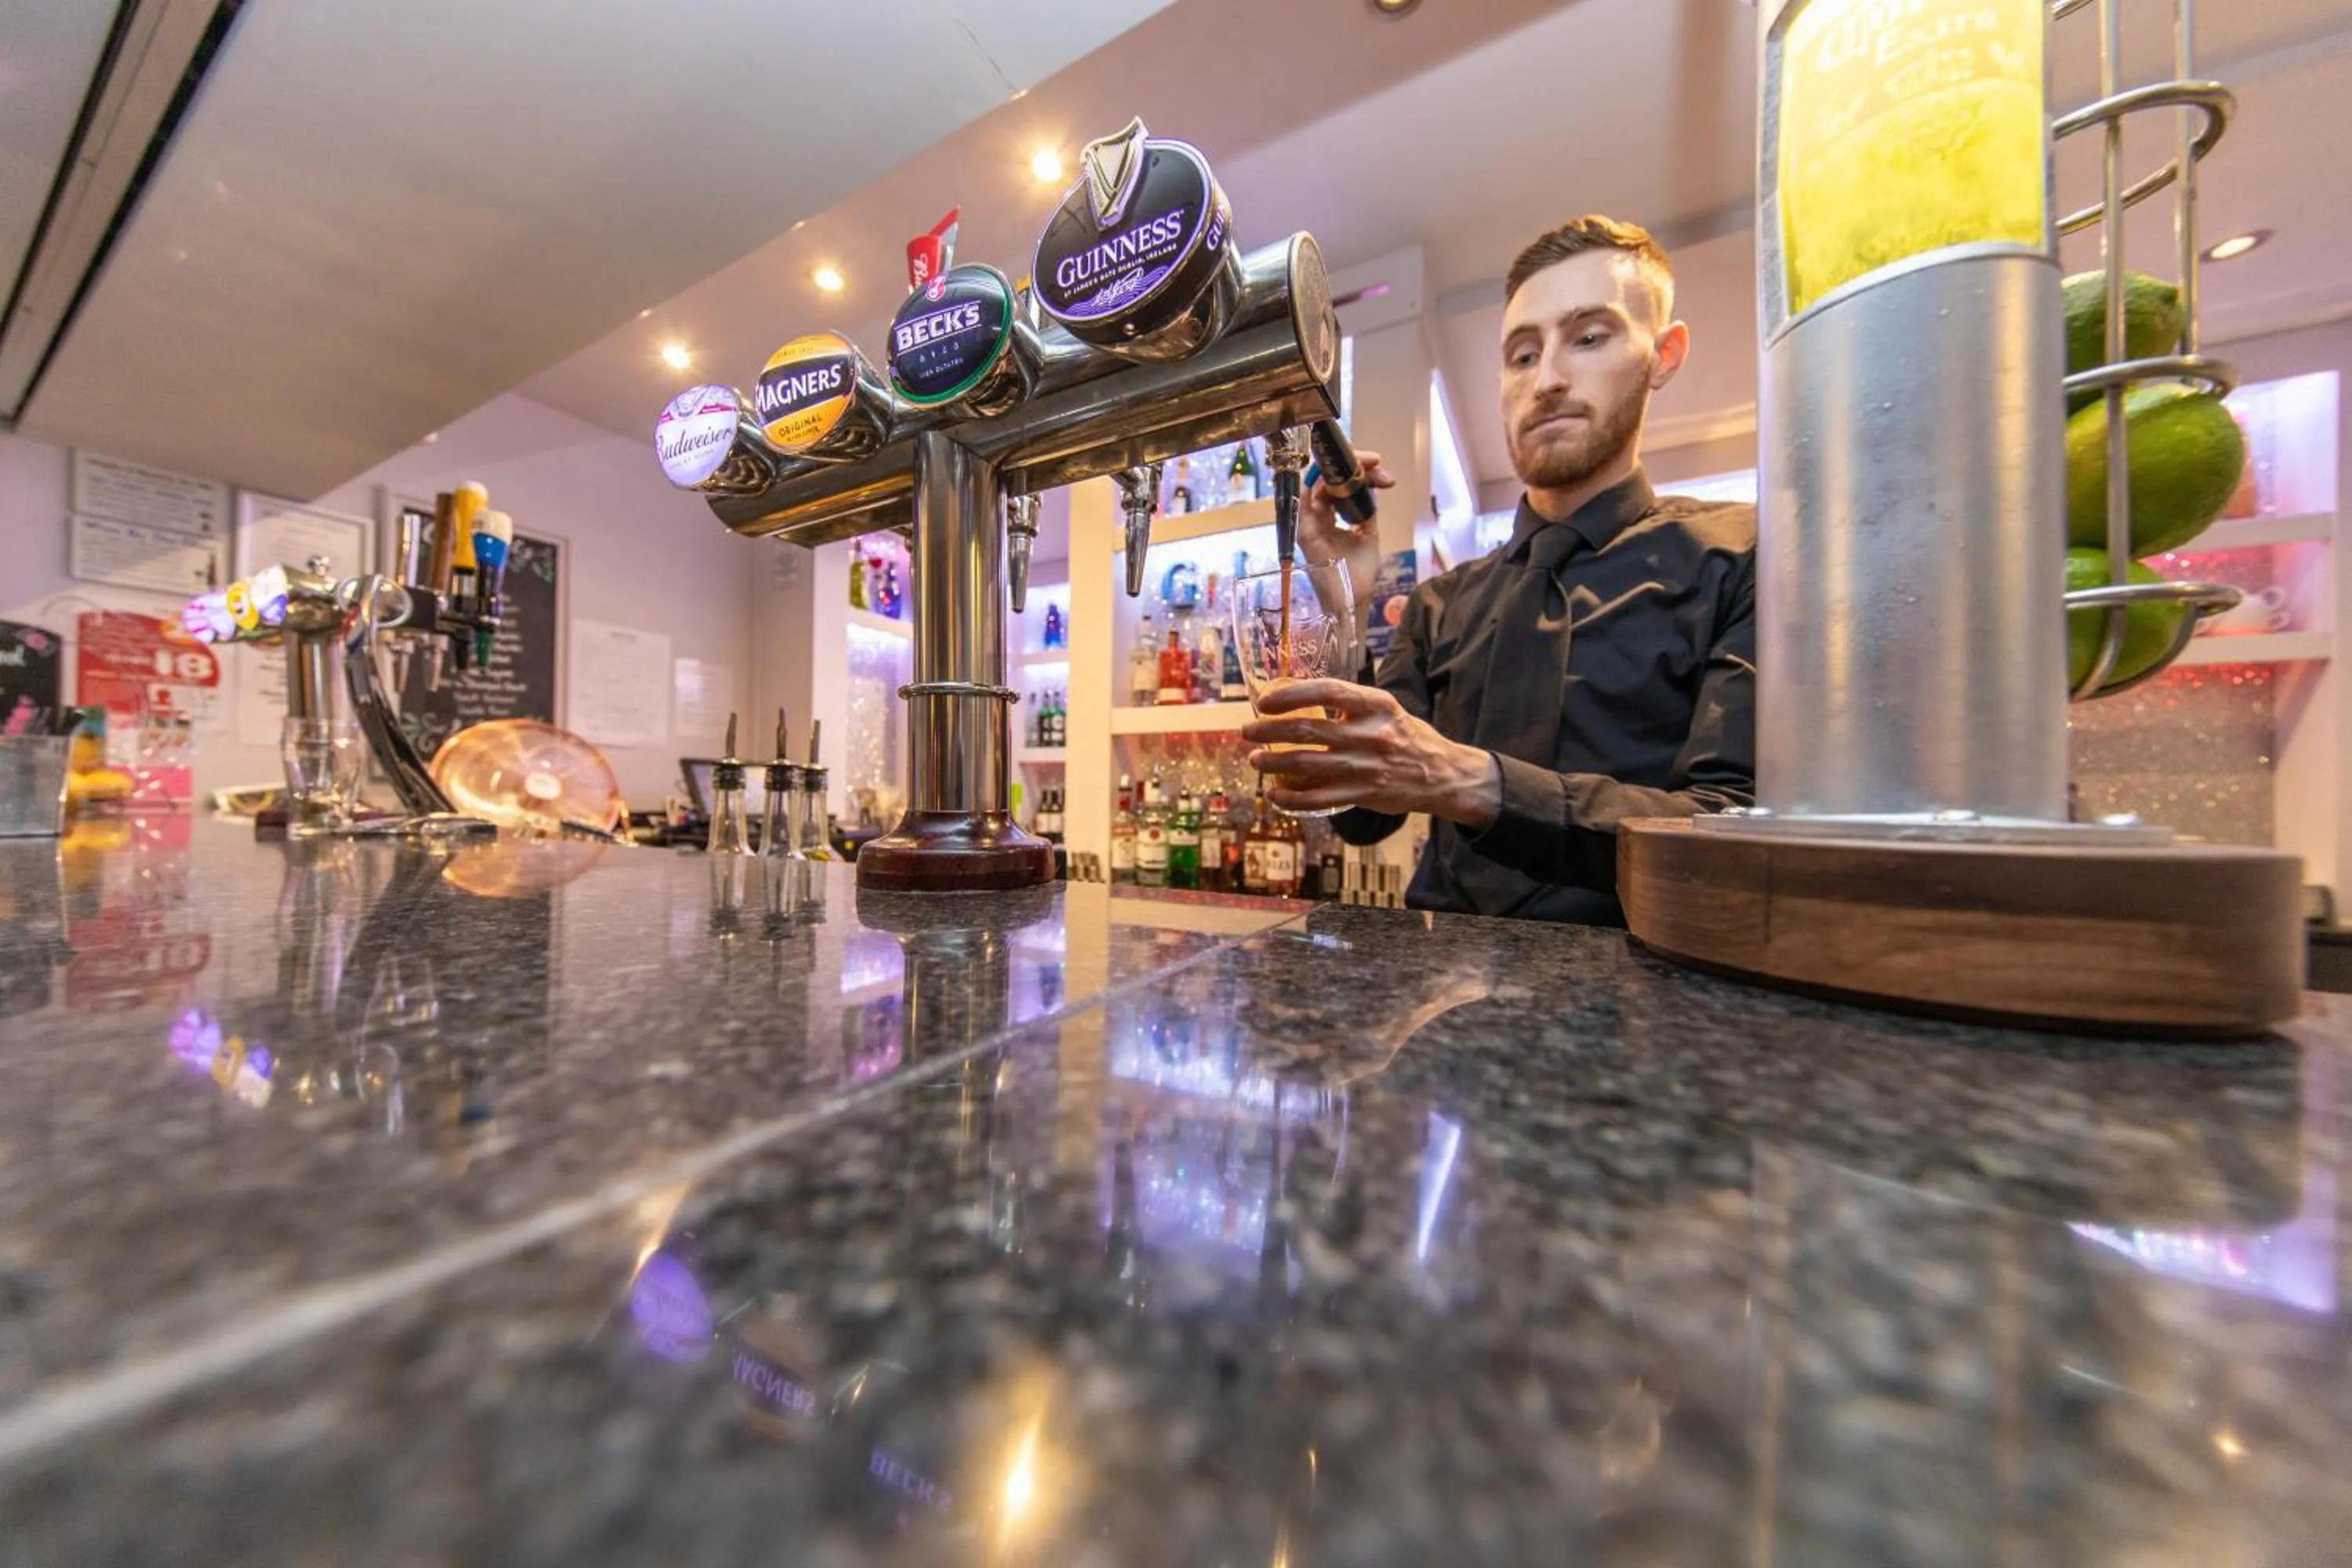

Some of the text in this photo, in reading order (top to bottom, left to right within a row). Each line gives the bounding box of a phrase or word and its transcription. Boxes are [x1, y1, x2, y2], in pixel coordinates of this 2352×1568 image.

[1057, 214, 1181, 288] GUINNESS
[896, 303, 980, 351] BECK'S
[757, 364, 842, 412] MAGNERS
[779, 413, 822, 437] ORIGINAL
